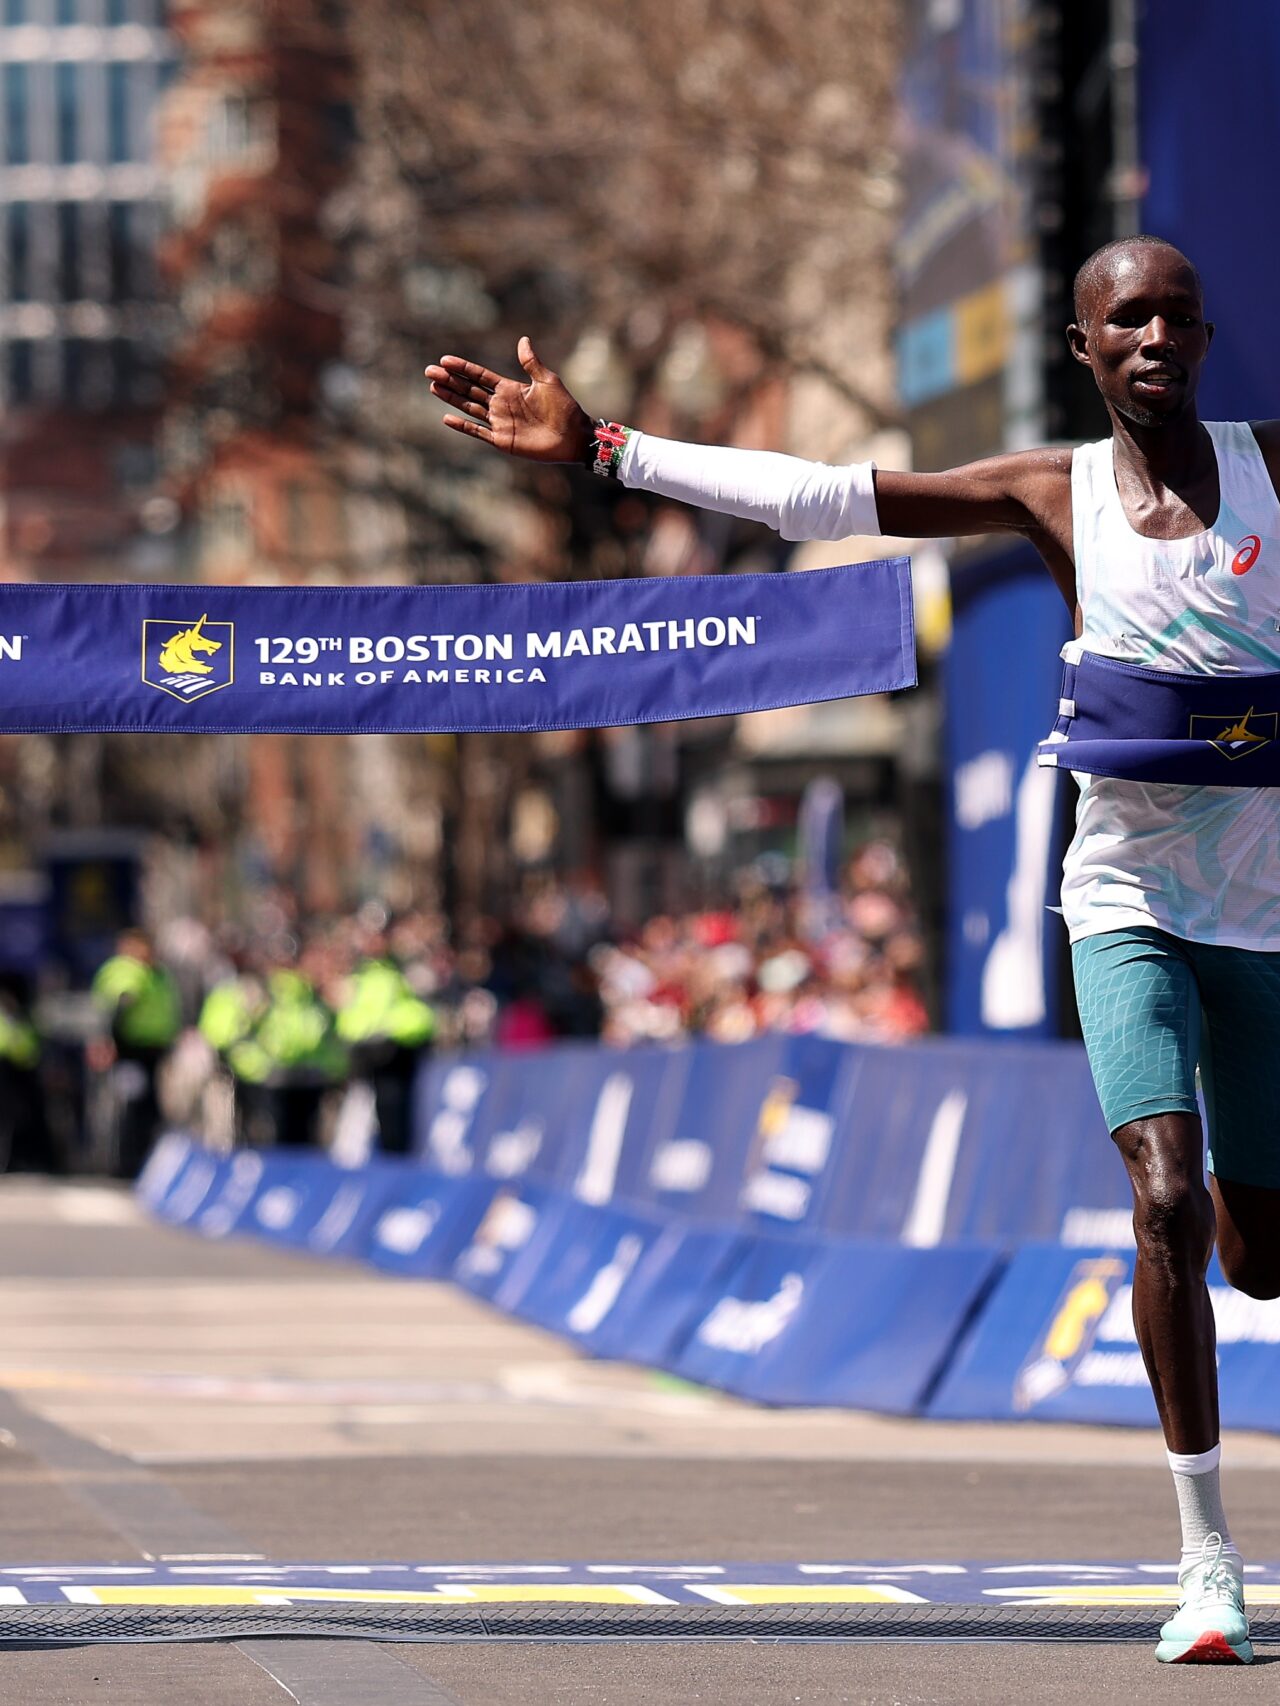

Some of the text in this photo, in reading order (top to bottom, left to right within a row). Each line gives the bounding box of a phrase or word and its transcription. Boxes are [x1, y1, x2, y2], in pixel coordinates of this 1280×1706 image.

[254, 615, 757, 664] 129TH BOSTON MARATHON
[259, 667, 547, 686] BANK OF AMERICA
